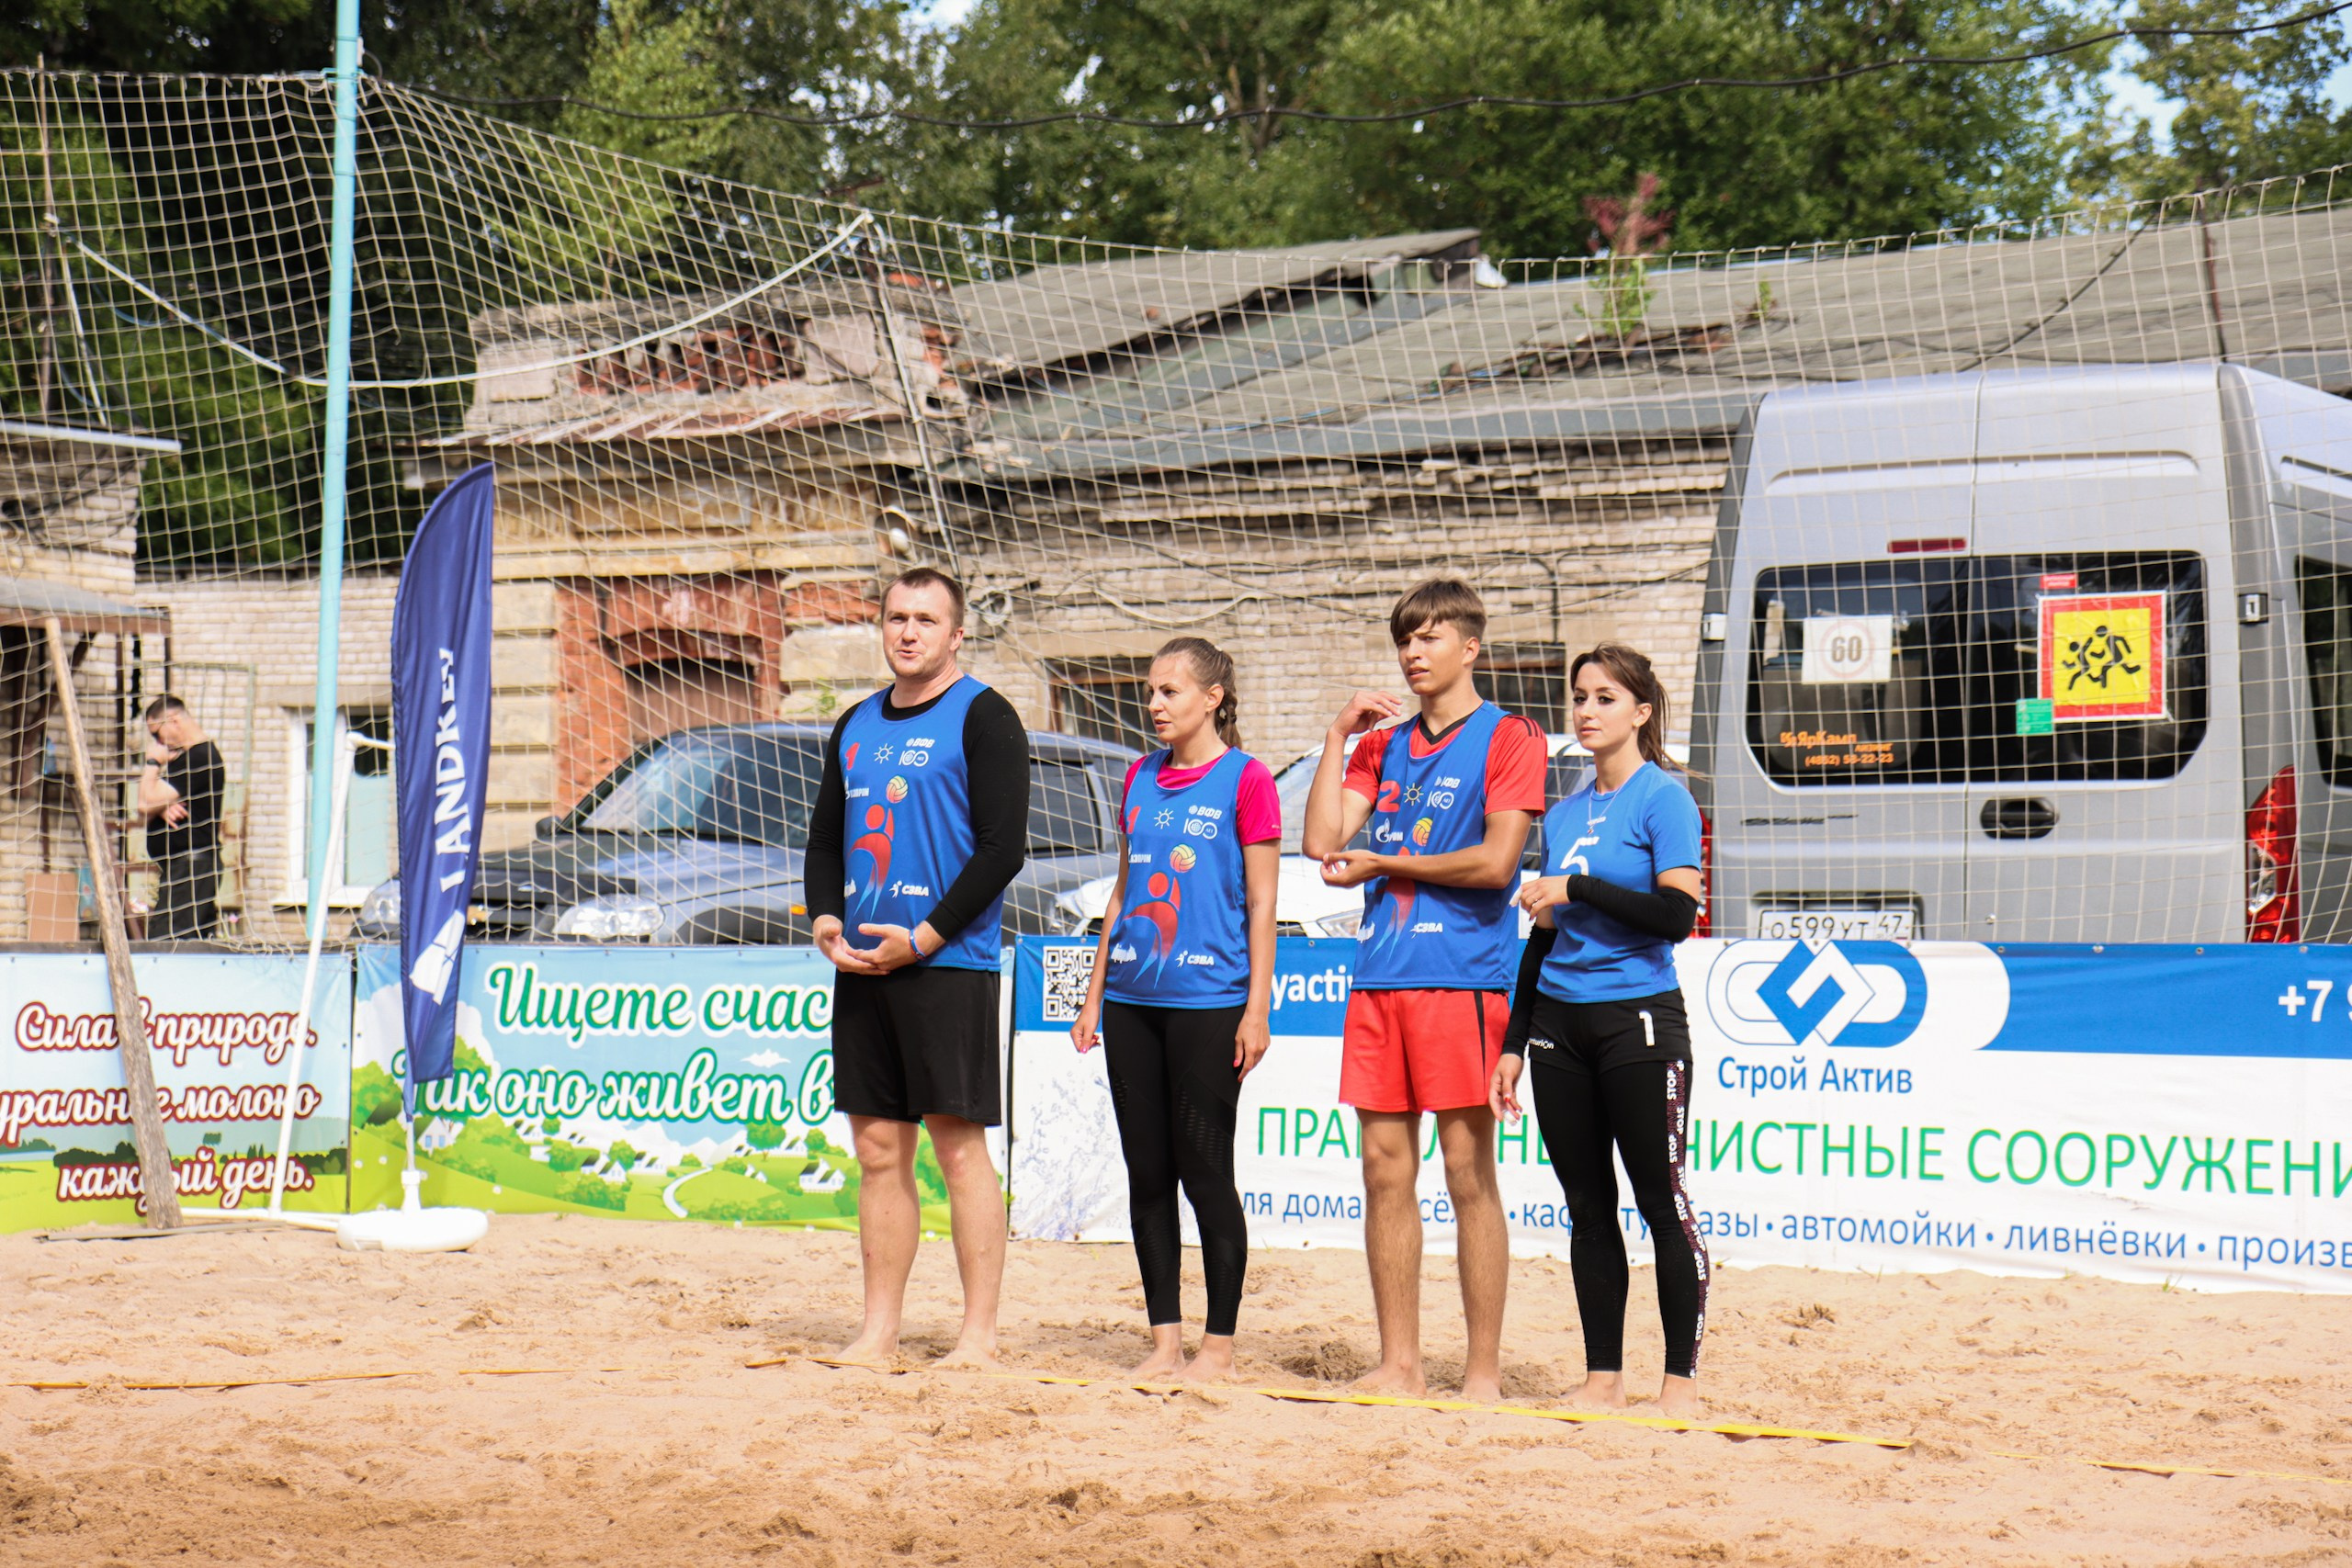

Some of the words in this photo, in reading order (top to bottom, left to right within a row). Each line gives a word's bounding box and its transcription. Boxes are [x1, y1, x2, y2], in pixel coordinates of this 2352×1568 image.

[1831, 635, 1862, 663] 60
[845, 741, 860, 770] 1
[1376, 779, 1400, 812] 2
[1126, 805, 1140, 834] 1
[1559, 836, 1600, 875] 5
[489, 966, 691, 1043] Ищете
[2278, 980, 2334, 1022] +7
[16, 1001, 120, 1052] Сила
[1638, 1010, 1654, 1046] 1
[494, 1068, 596, 1121] оно
[599, 1046, 793, 1124] живет
[1666, 1070, 1677, 1100] STOP
[1717, 1055, 1807, 1098] Строй
[1819, 1058, 1914, 1095] Актив
[1676, 1106, 1685, 1135] STOP
[1668, 1134, 1678, 1164] STOP
[1673, 1192, 1689, 1222] STOP
[1243, 1191, 1272, 1215] ля
[1283, 1193, 1362, 1224] дома
[1781, 1210, 1976, 1249] автомойки
[2005, 1223, 2187, 1259] ливнёвки
[1694, 1250, 1707, 1280] STOP
